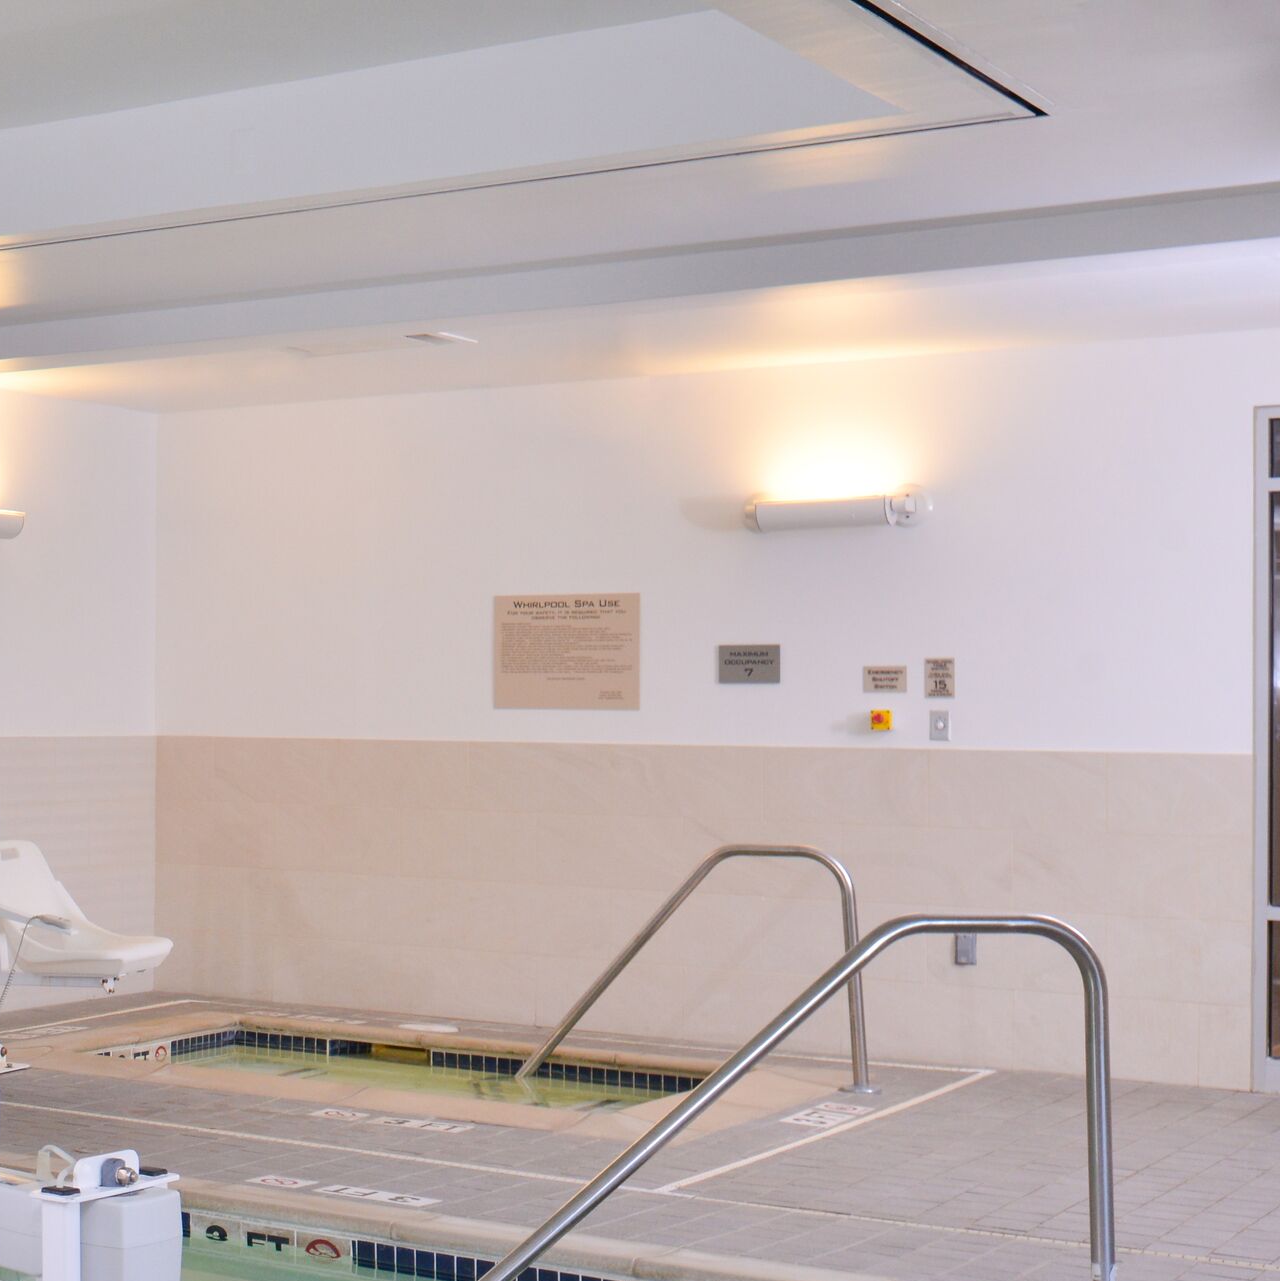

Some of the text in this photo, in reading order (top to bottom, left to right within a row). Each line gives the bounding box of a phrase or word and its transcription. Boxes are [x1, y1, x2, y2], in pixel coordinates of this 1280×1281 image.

[513, 600, 620, 608] WHIRLPOOL SPA USE
[744, 668, 753, 677] 7
[934, 680, 947, 689] 15
